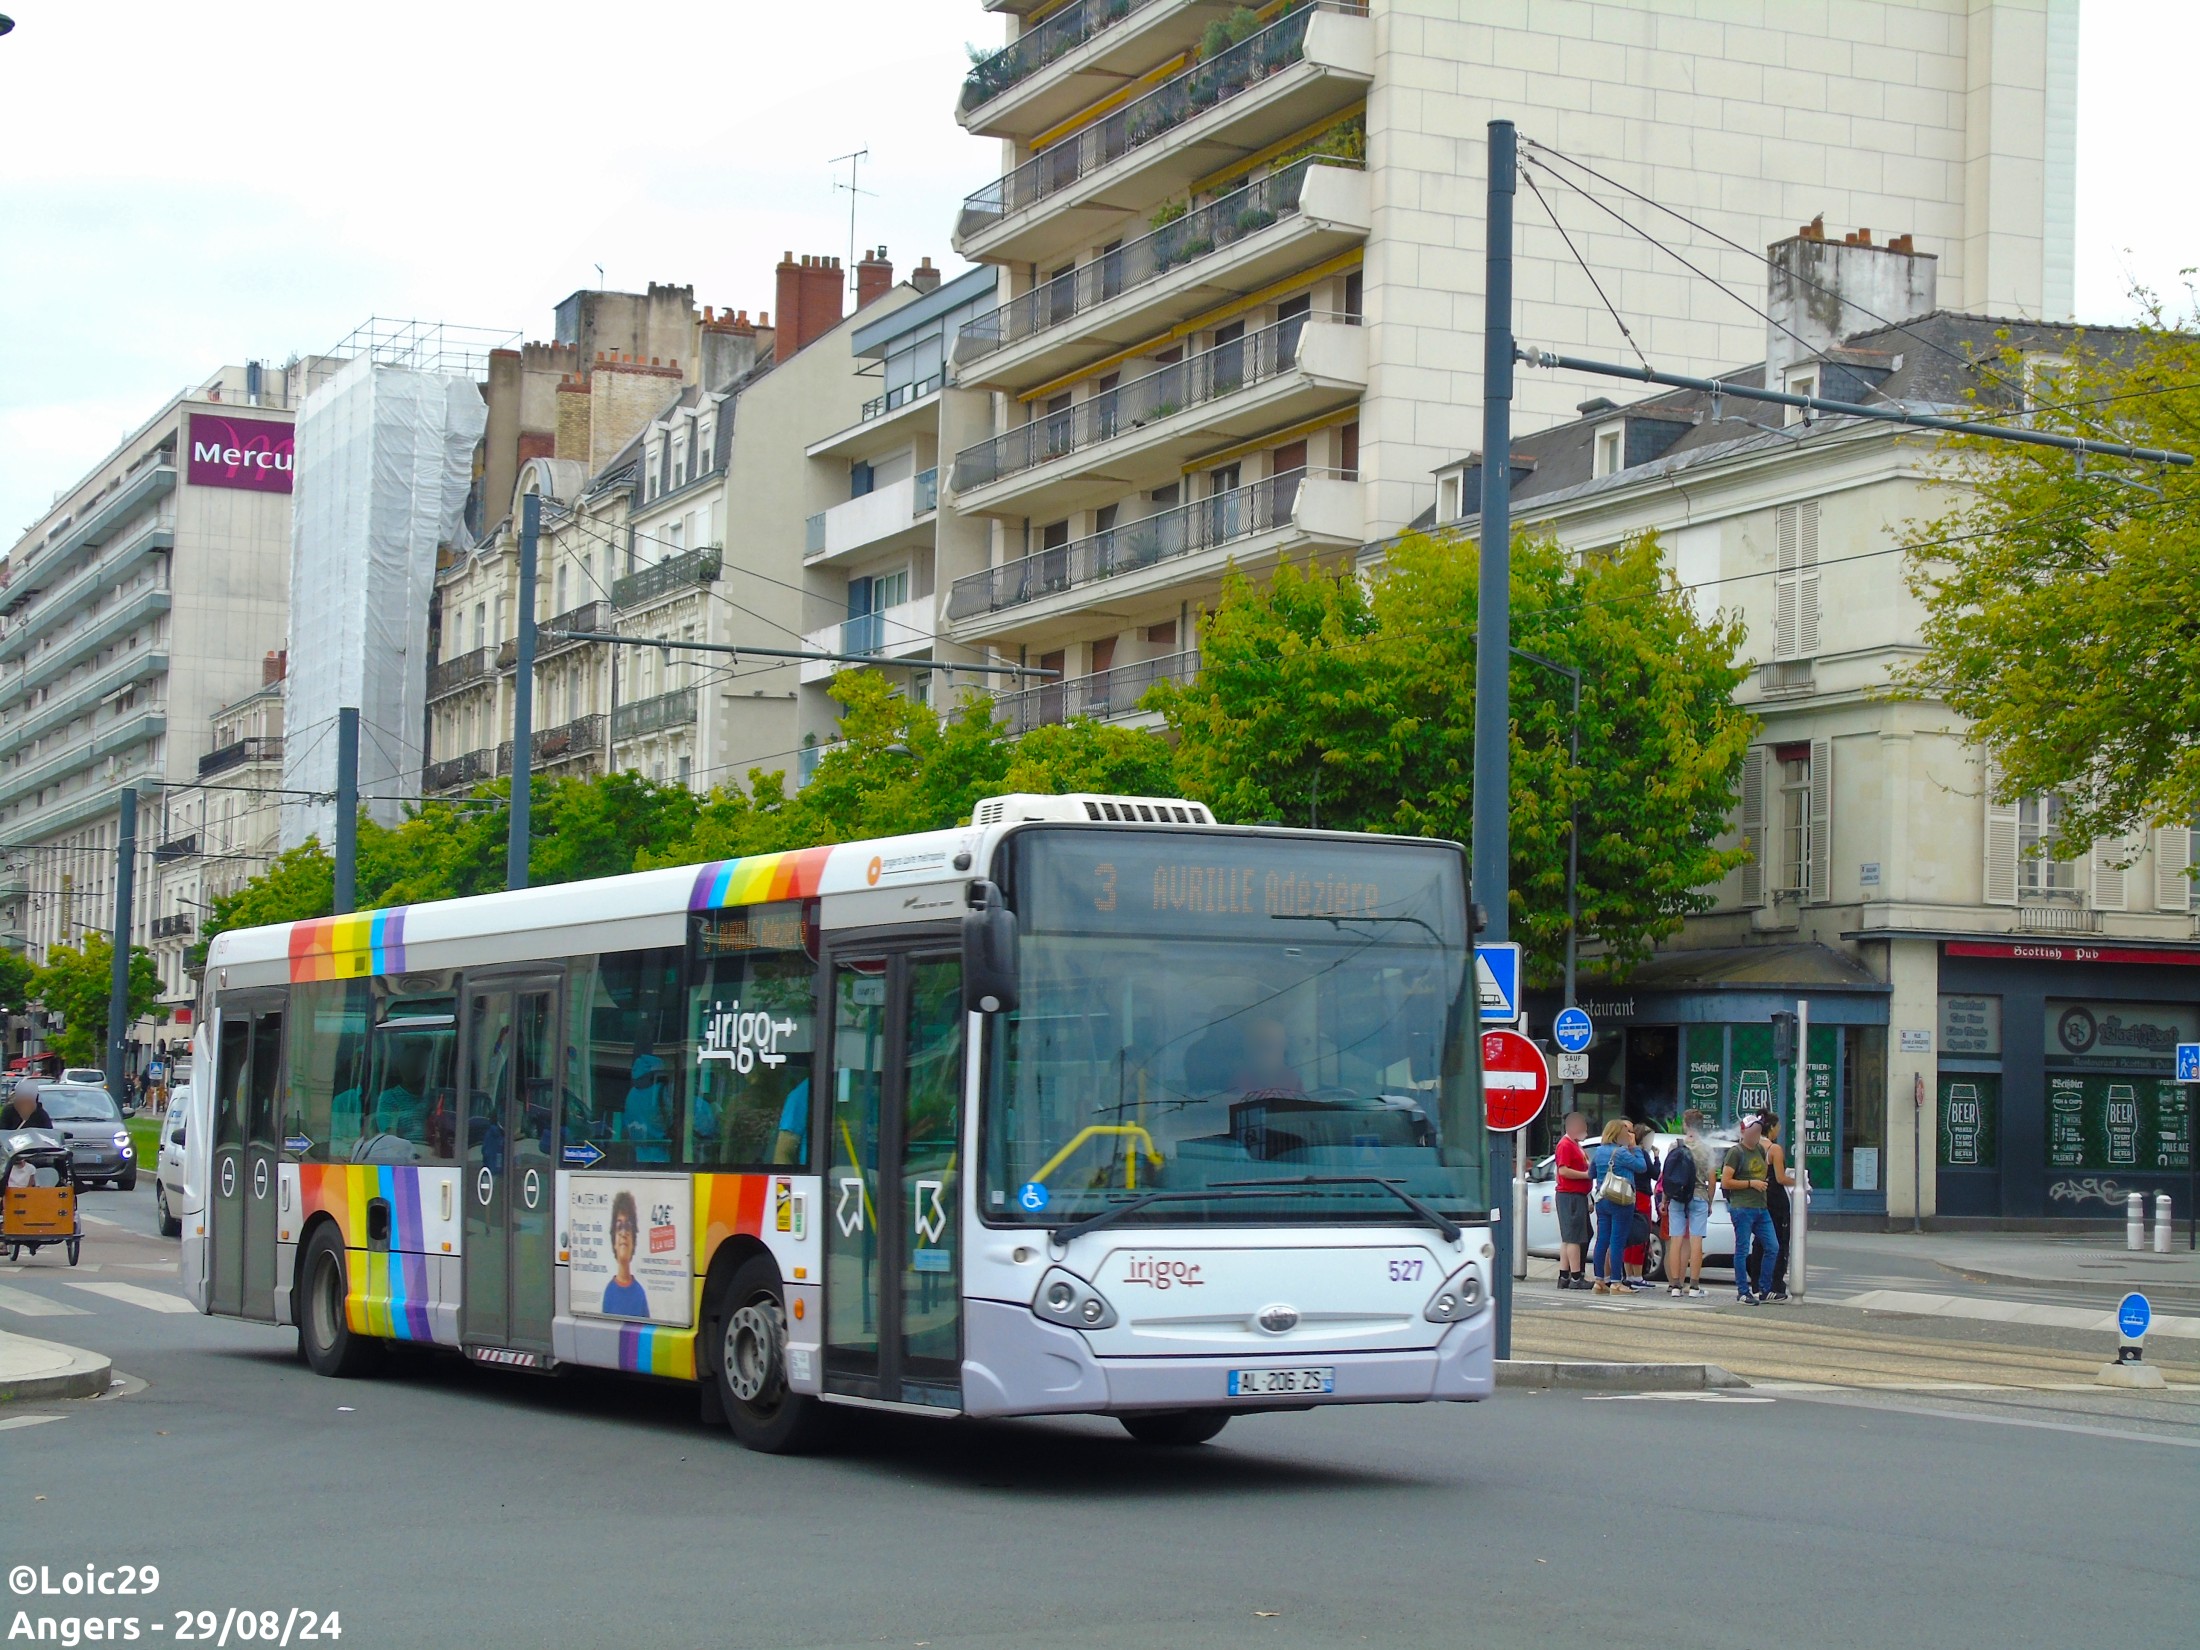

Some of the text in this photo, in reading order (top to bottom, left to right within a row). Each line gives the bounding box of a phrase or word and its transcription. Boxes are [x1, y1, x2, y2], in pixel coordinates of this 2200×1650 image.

[194, 441, 292, 470] Mercu
[1094, 863, 1117, 912] 3
[1153, 865, 1254, 913] AVRILLE
[2014, 946, 2099, 960] Scottish Pub
[1742, 1089, 1767, 1109] BEER
[1952, 1103, 1975, 1123] BEER
[2110, 1103, 2133, 1123] BEER
[1817, 1131, 1830, 1141] ALE
[2163, 1143, 2189, 1152] PALE ALE
[1389, 1260, 1424, 1281] 527
[1240, 1371, 1322, 1392] AL-206-ZS
